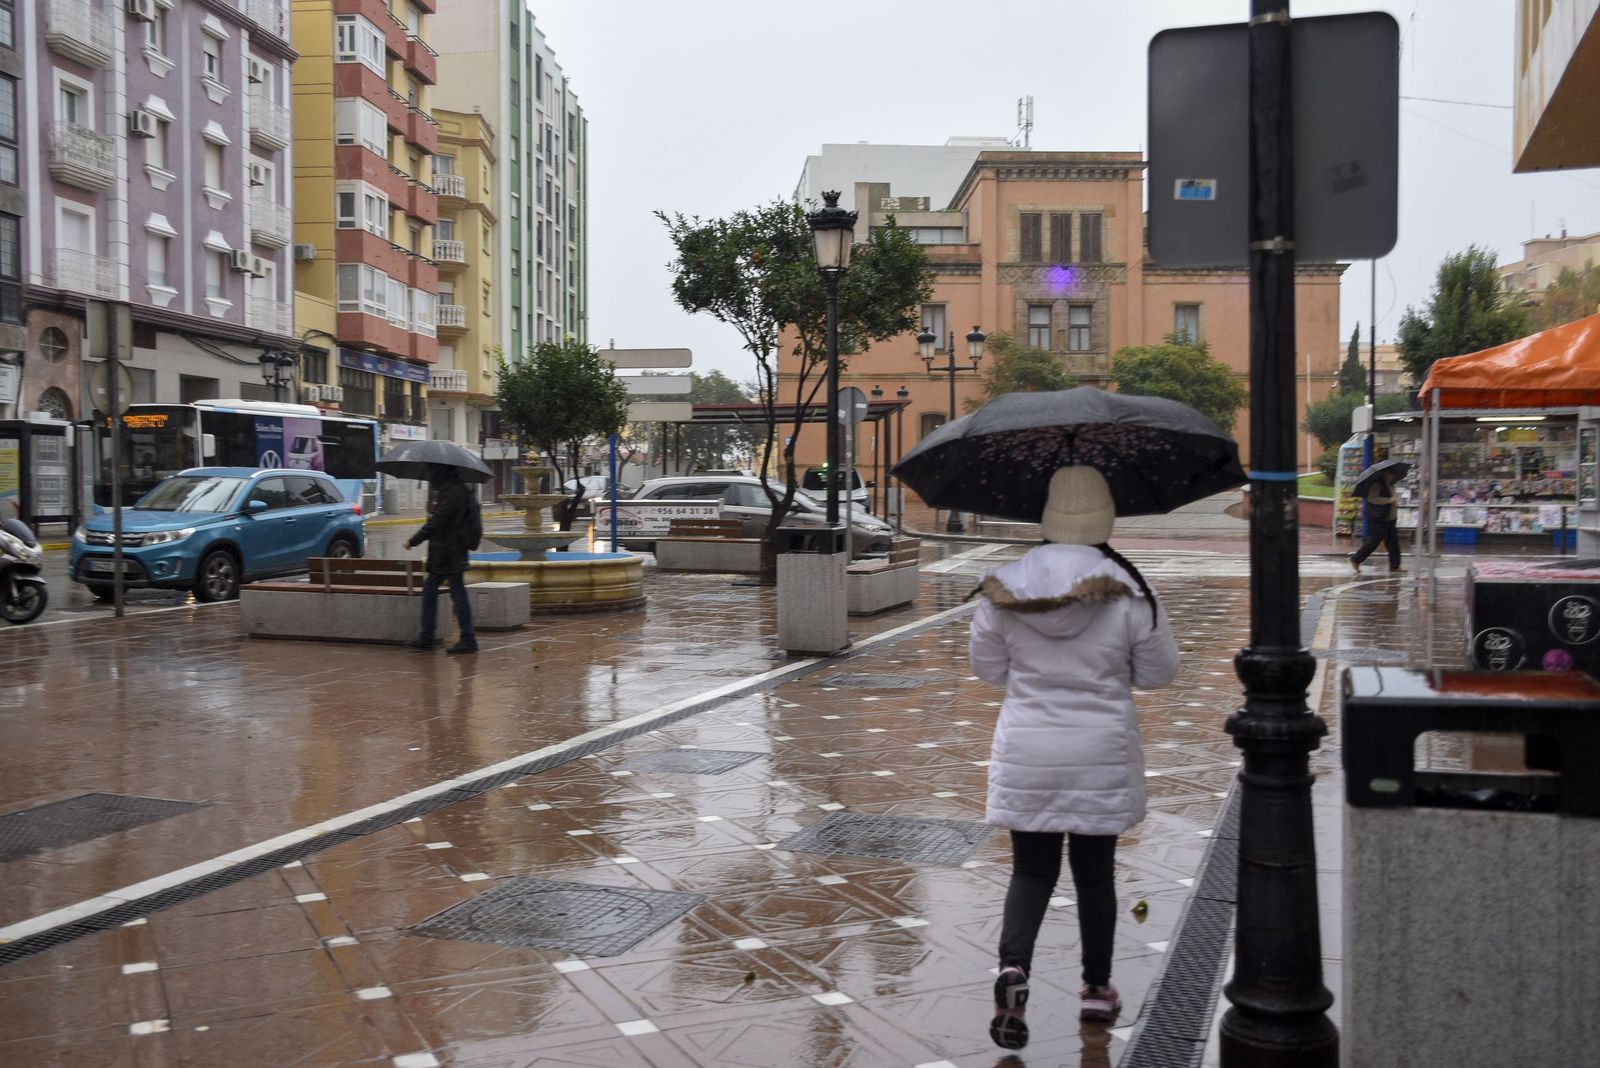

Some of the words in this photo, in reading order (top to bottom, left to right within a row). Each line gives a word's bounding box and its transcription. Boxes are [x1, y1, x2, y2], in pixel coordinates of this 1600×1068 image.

[657, 507, 673, 515] 956
[676, 507, 687, 515] 64
[689, 507, 699, 515] 31
